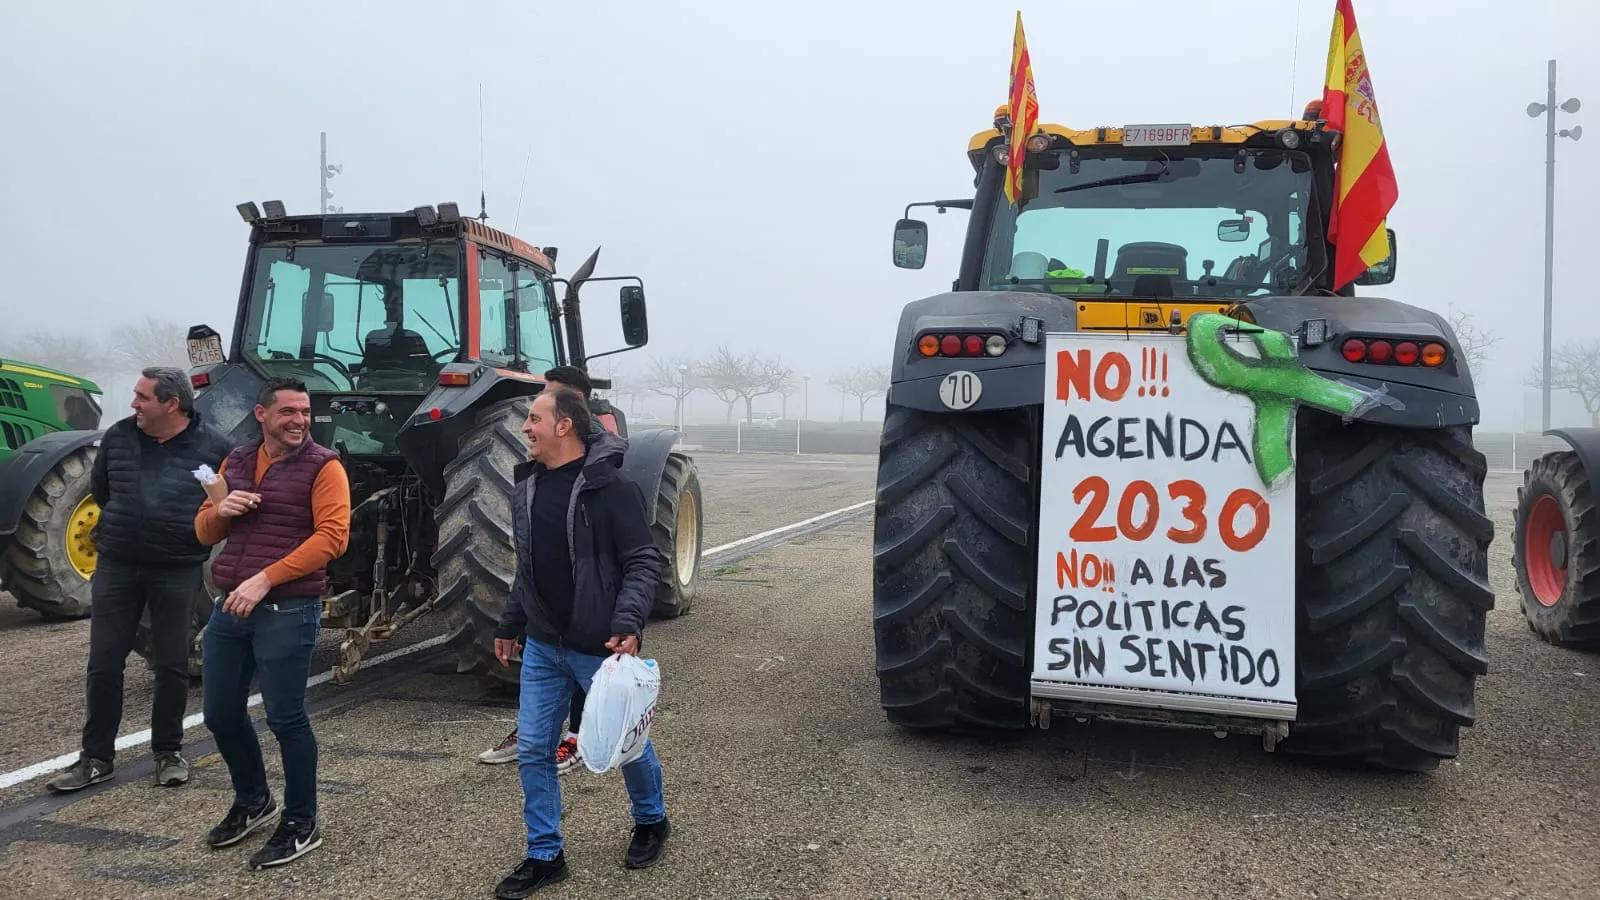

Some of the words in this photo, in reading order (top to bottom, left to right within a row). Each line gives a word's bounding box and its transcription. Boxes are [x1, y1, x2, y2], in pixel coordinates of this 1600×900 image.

[948, 374, 972, 406] 70
[1054, 413, 1253, 465] AGENDA
[1069, 476, 1270, 552] 2030
[1131, 558, 1154, 587] A
[1162, 554, 1227, 590] LAS
[1047, 635, 1106, 679] SIN
[1119, 634, 1281, 687] SENTIDO
